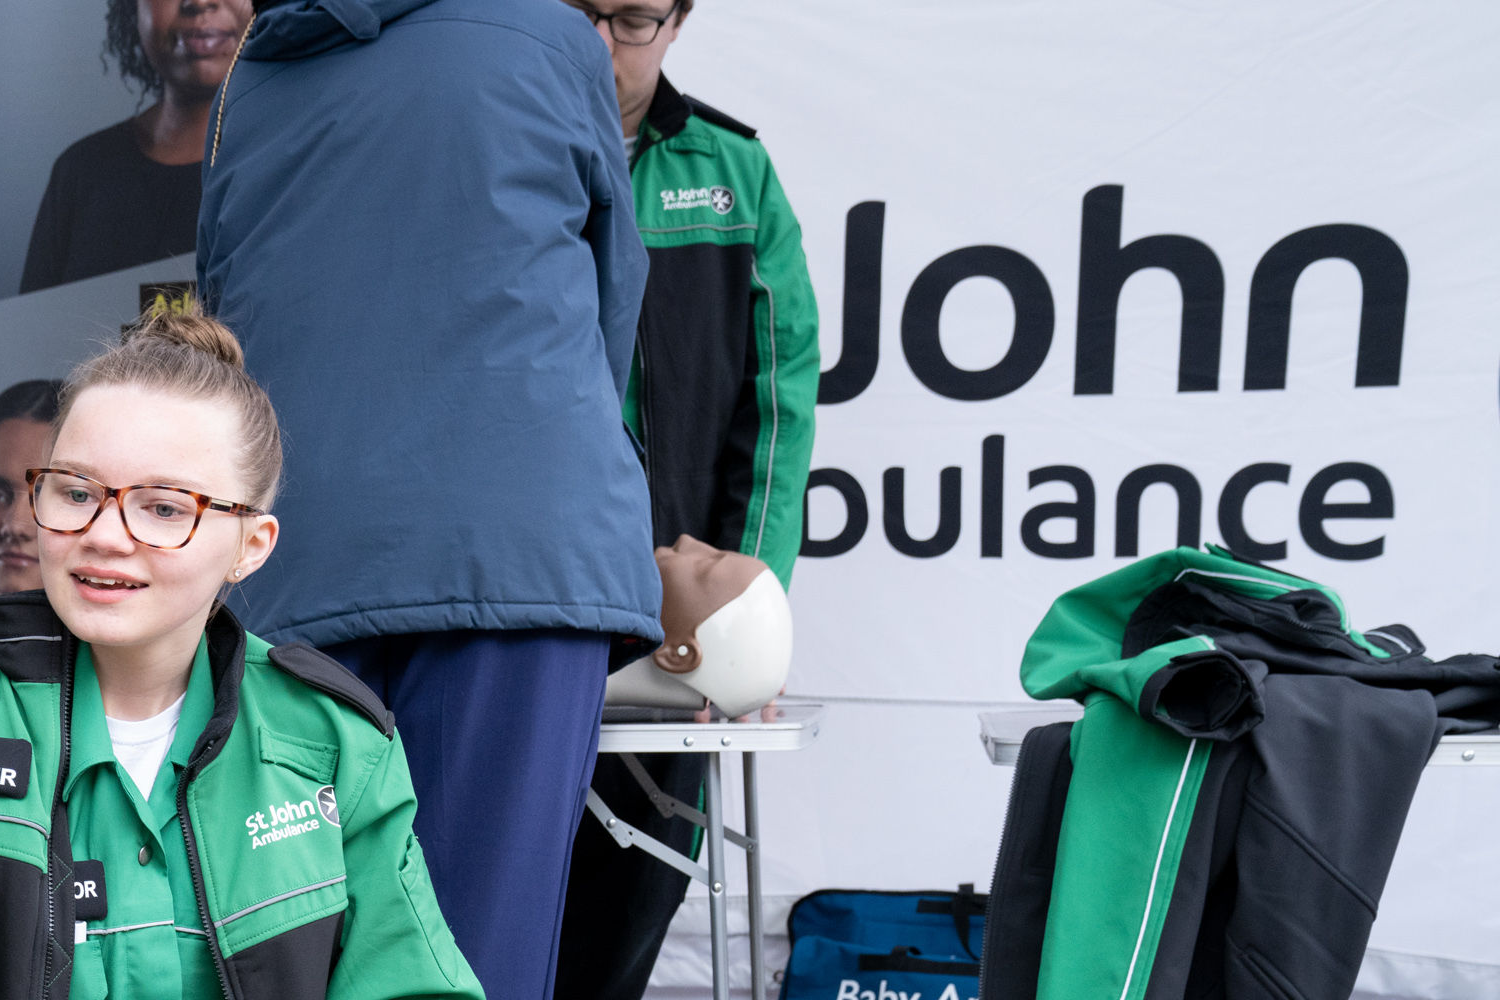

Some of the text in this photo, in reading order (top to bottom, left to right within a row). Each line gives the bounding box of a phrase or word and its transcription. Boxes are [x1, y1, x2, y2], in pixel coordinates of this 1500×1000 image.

[678, 187, 709, 201] John
[816, 183, 1409, 405] John
[798, 434, 1395, 562] bulance
[245, 800, 316, 836] St John
[252, 819, 320, 850] Ambulance
[74, 880, 98, 900] OR
